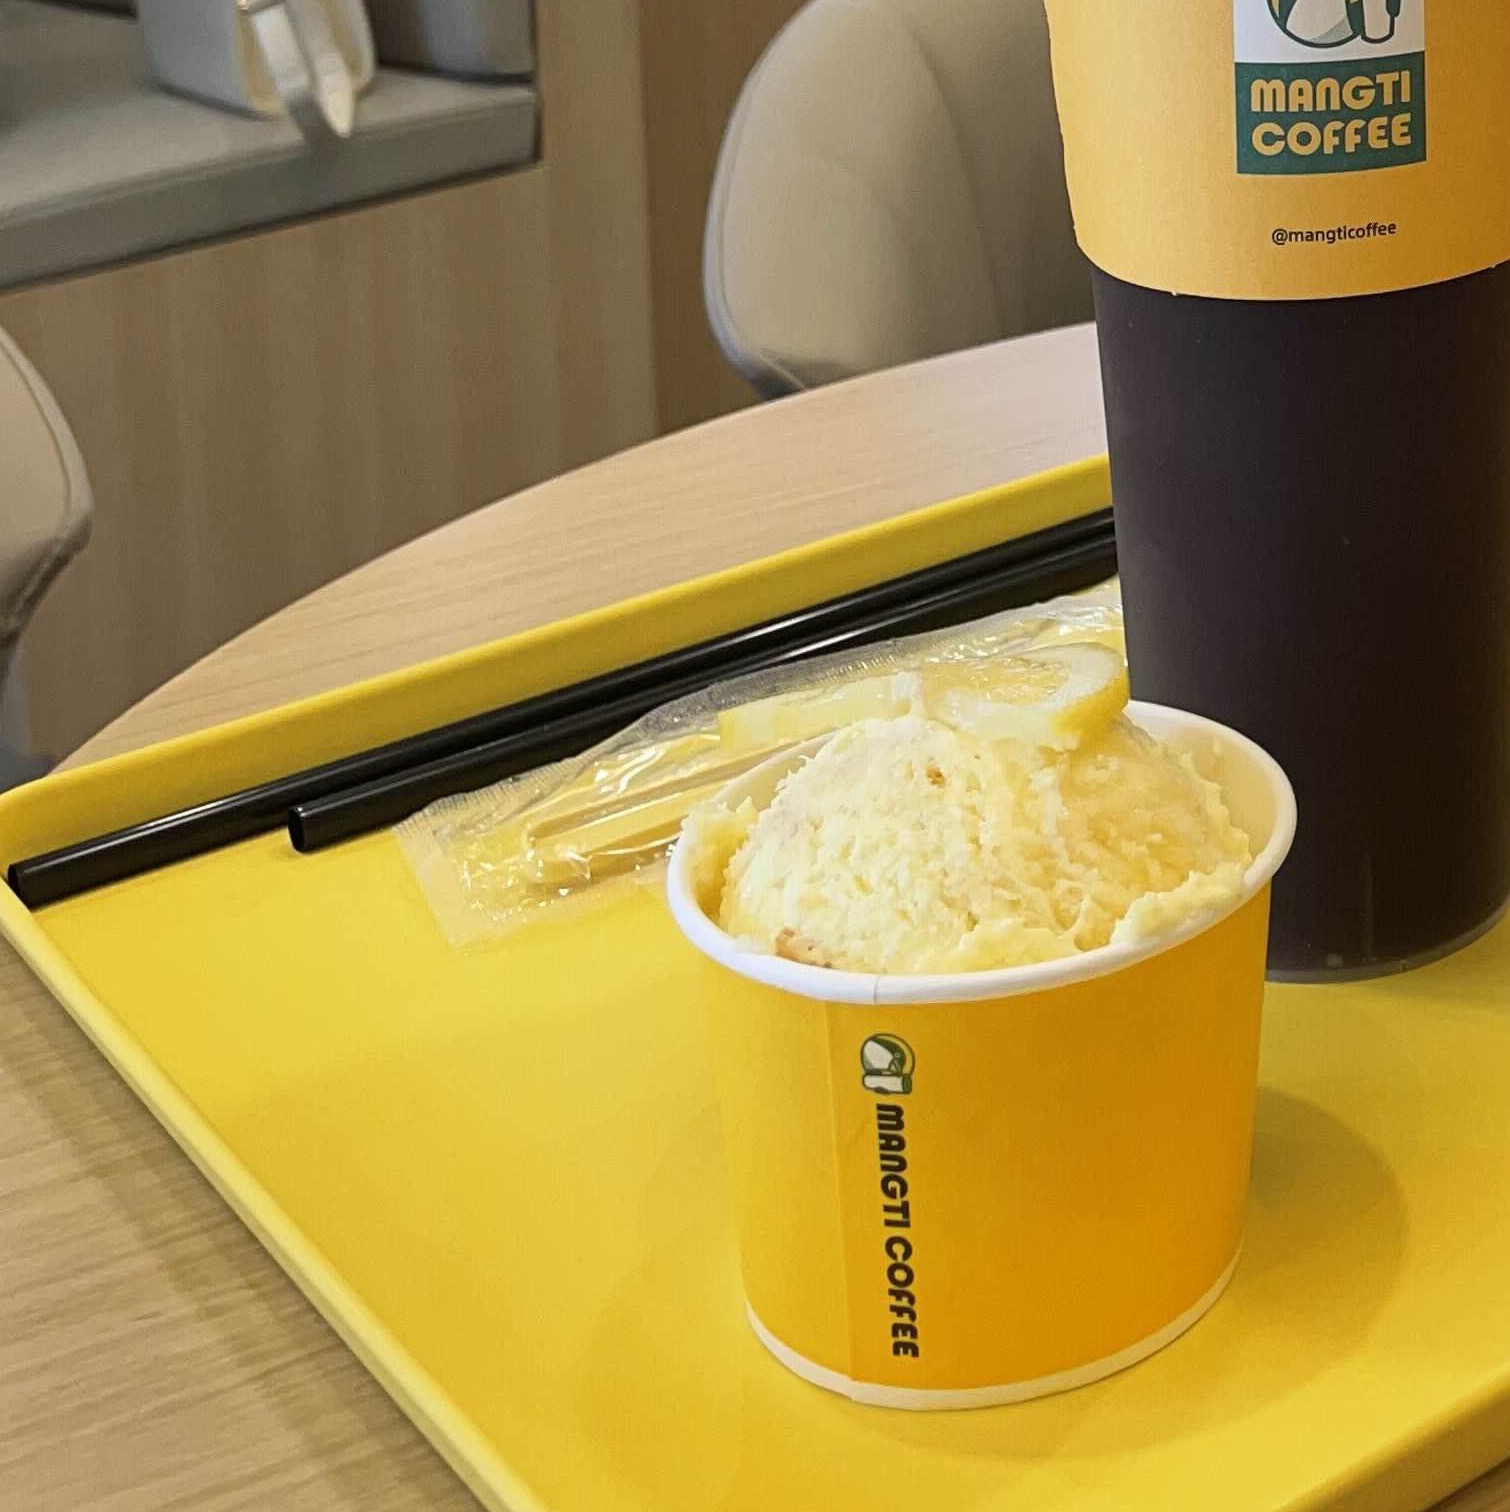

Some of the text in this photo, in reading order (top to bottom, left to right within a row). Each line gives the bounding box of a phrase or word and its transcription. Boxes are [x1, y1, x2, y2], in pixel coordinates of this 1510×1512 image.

[1250, 70, 1411, 112] MANGTI
[1252, 113, 1412, 156] COFFEE
[1272, 222, 1397, 245] @mangticoffee
[876, 1103, 919, 1358] MANGTI COFFEE
